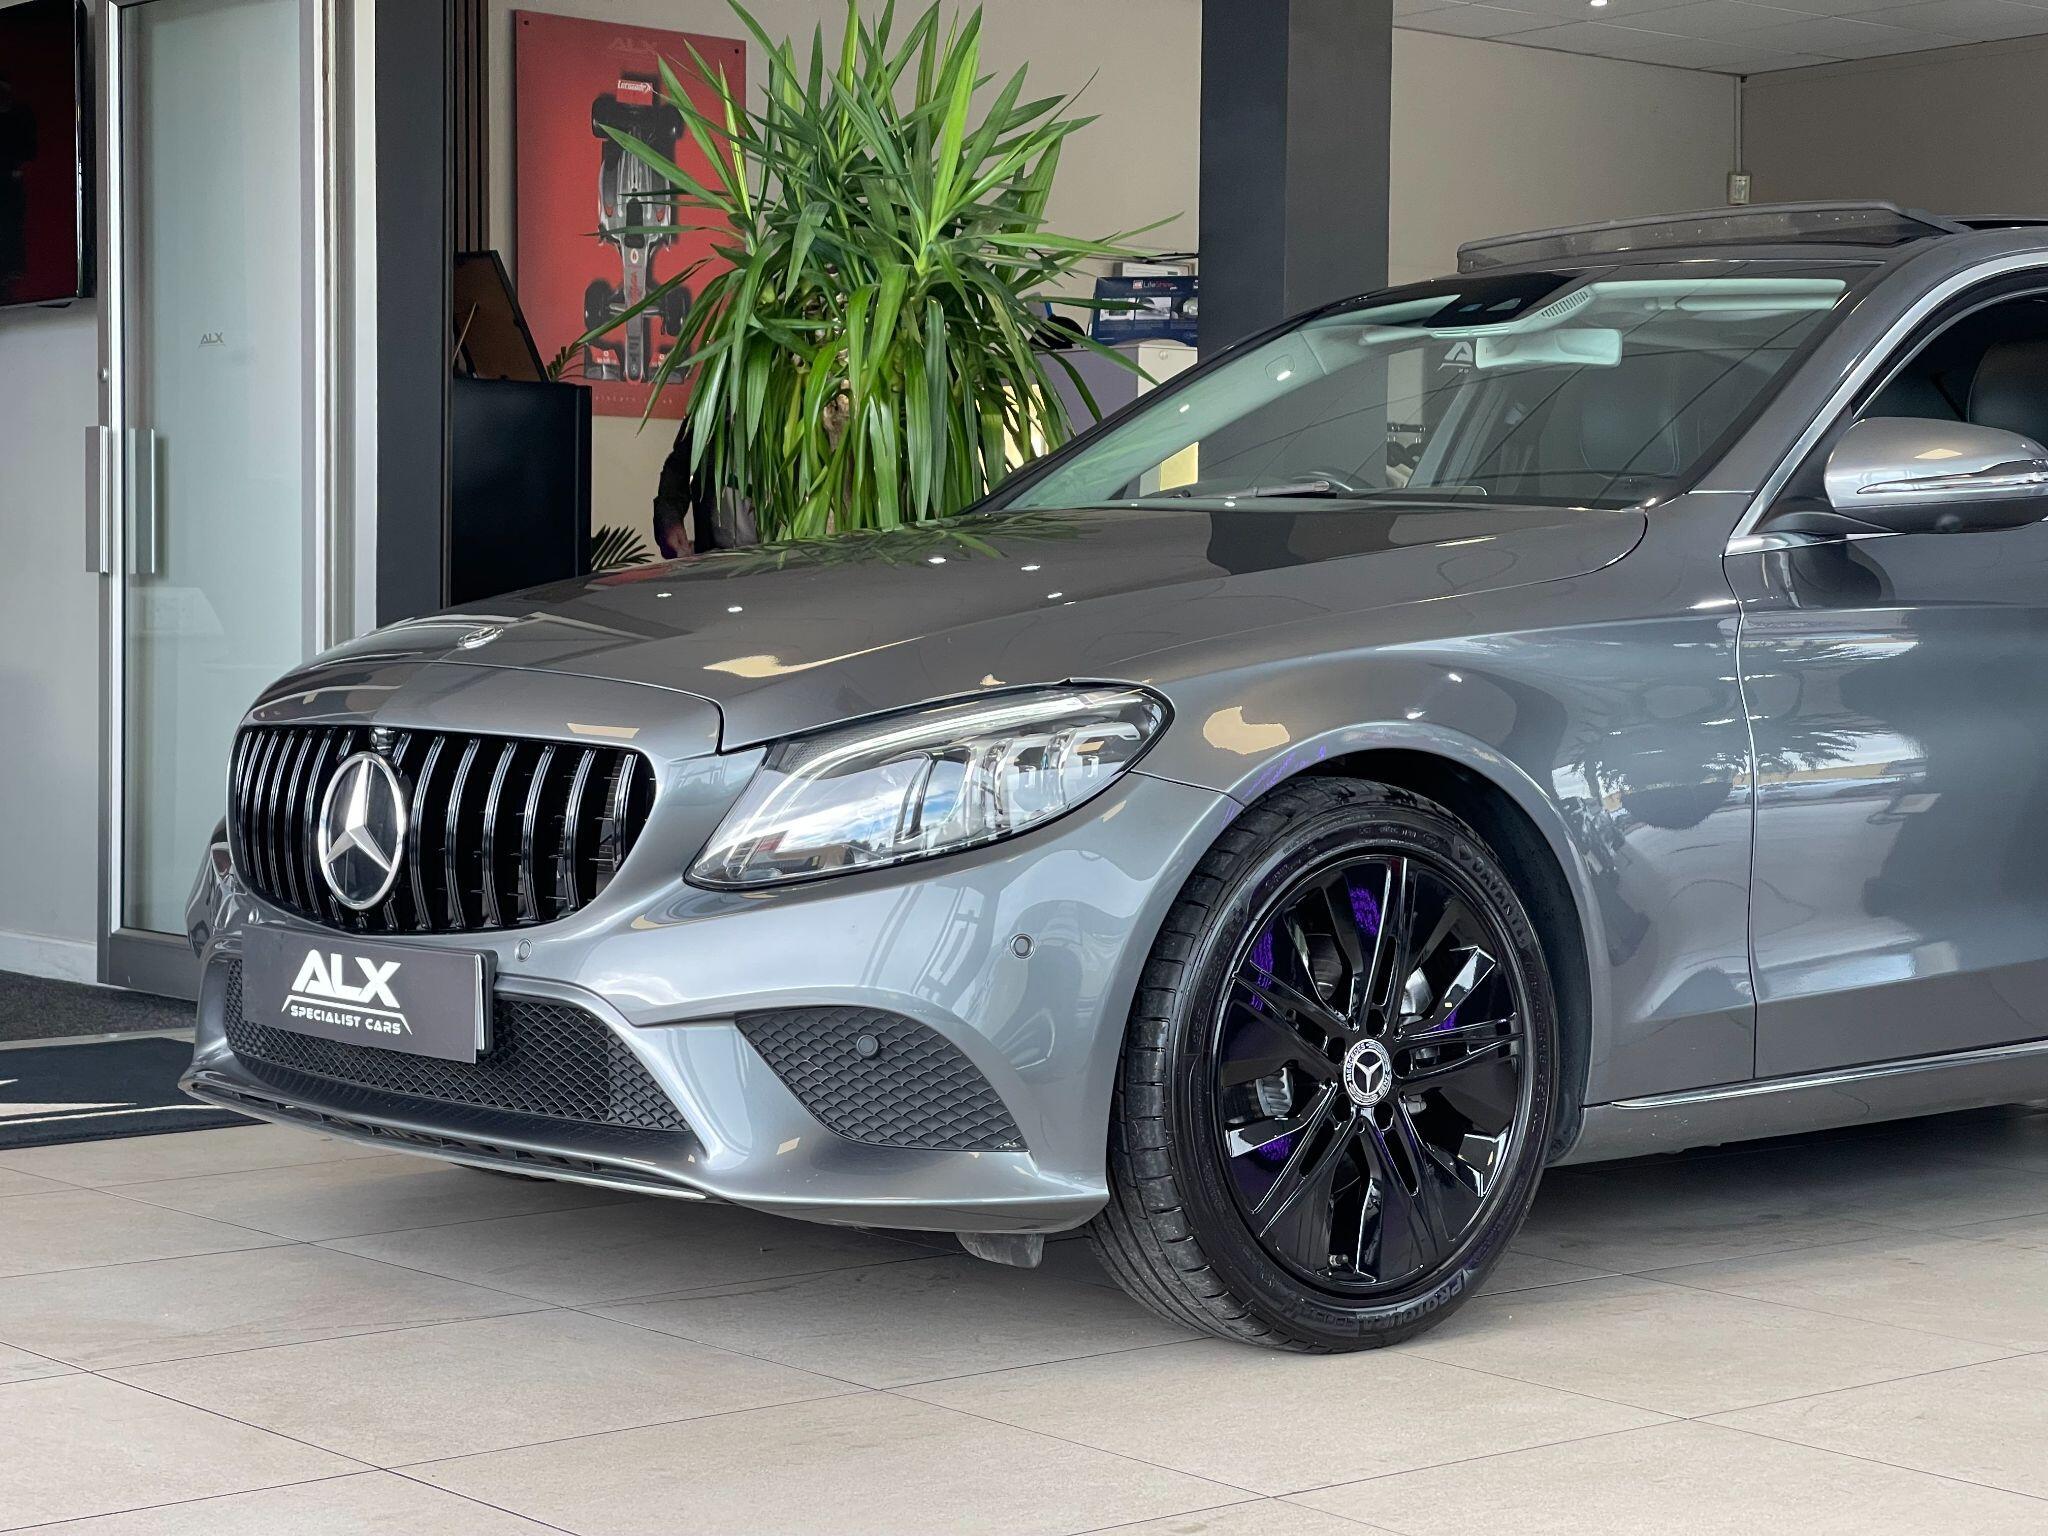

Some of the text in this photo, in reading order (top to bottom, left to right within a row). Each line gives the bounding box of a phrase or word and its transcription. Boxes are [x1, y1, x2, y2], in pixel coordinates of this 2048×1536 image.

[200, 332, 224, 345] ALX
[291, 949, 402, 1009] ALX
[290, 1005, 402, 1035] SPECIALIST CARS
[1346, 1043, 1366, 1081] MERCEDES
